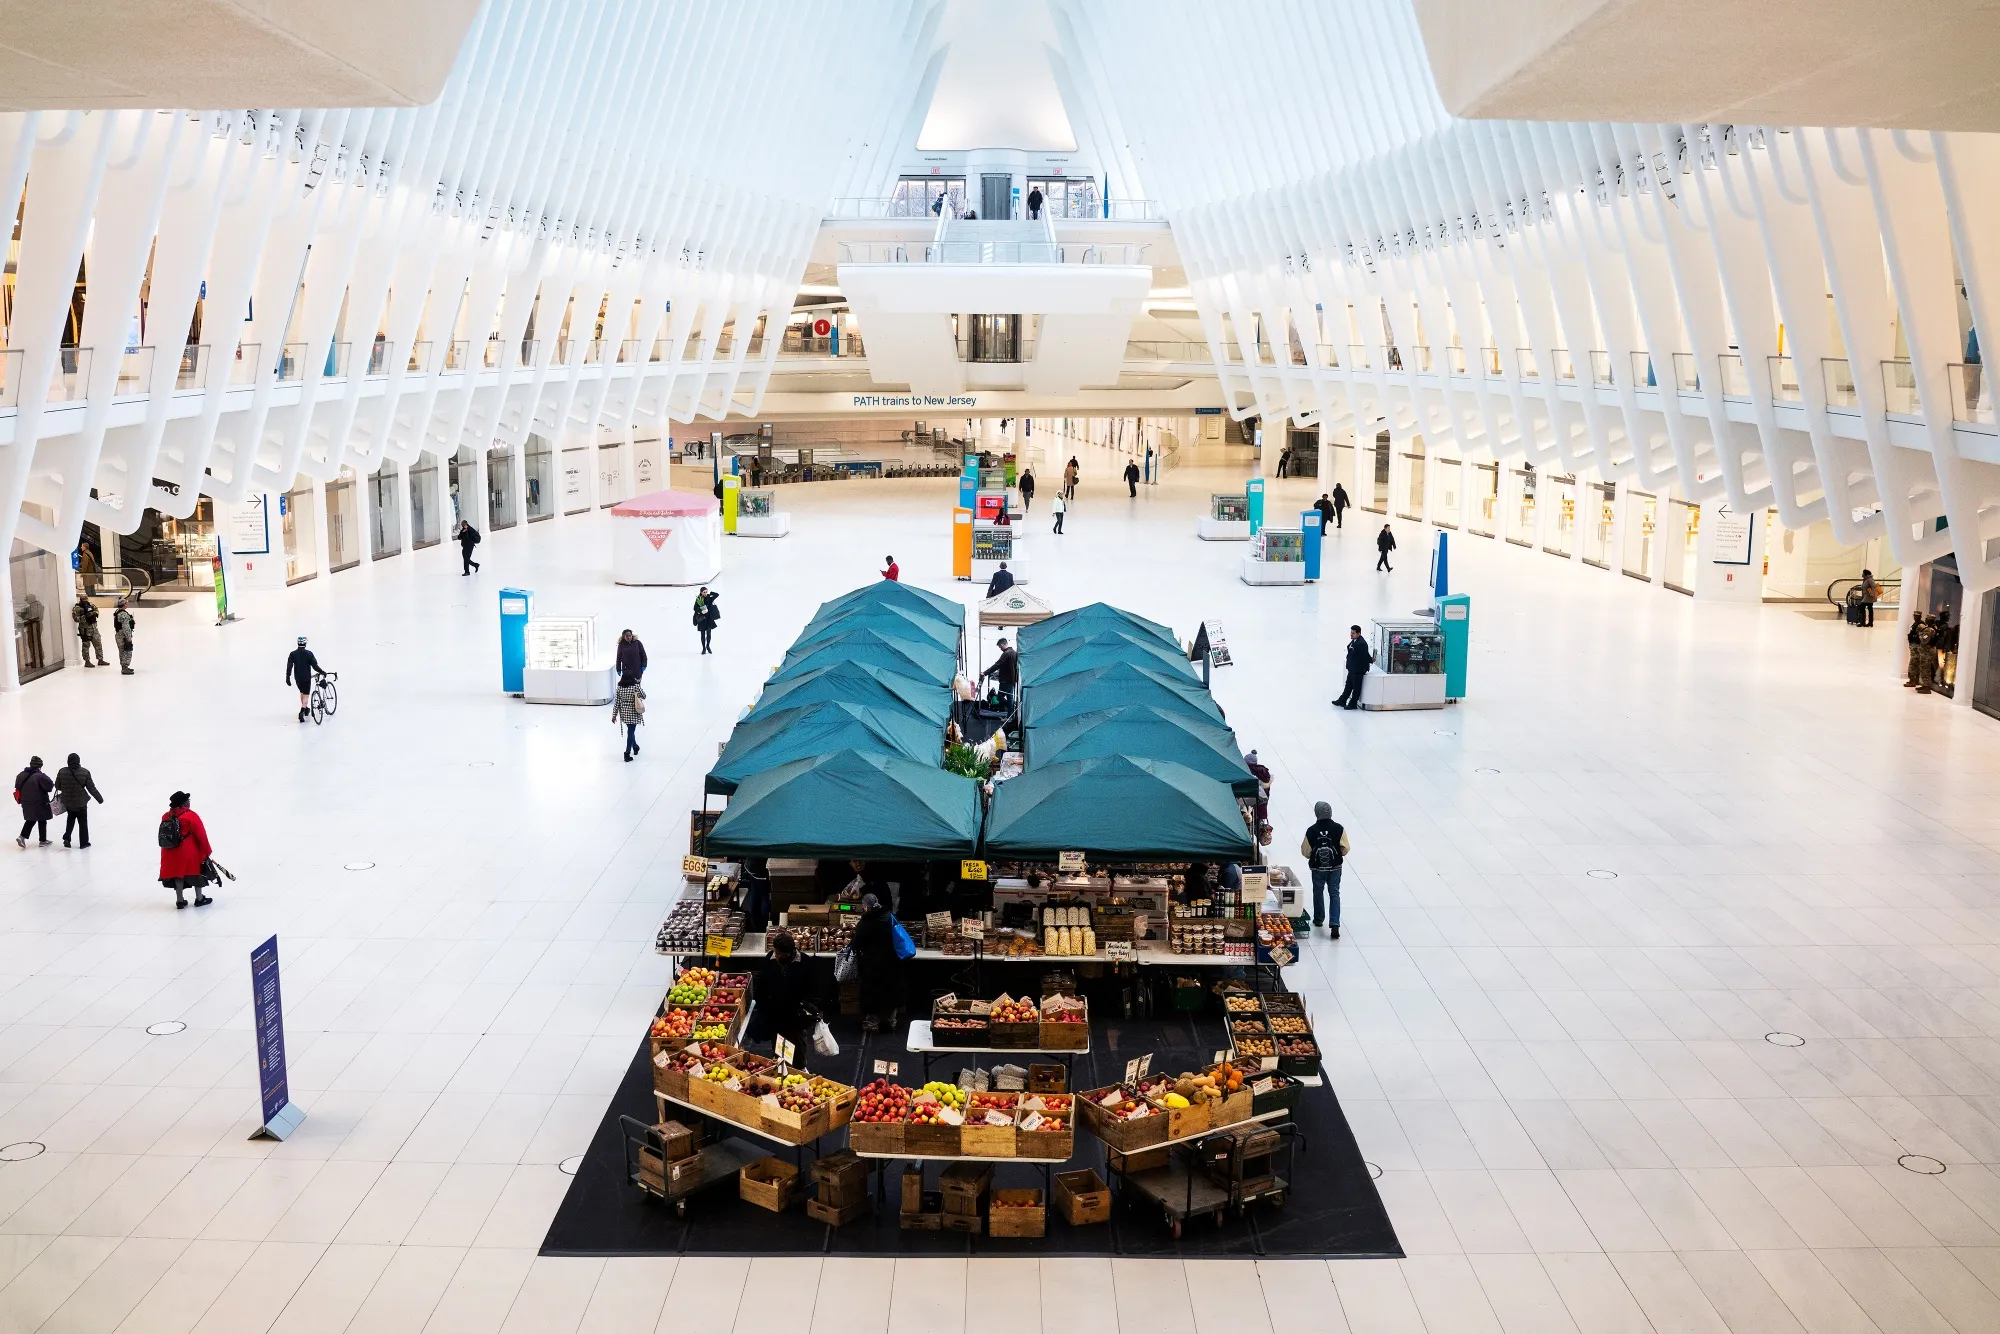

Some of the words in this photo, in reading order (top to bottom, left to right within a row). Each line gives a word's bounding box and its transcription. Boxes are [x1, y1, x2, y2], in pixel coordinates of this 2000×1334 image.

[853, 396, 880, 406] PATH
[882, 396, 910, 406] trains
[912, 396, 922, 405] to
[924, 395, 945, 405] New
[946, 395, 977, 407] Jersey
[683, 859, 706, 873] EGGS
